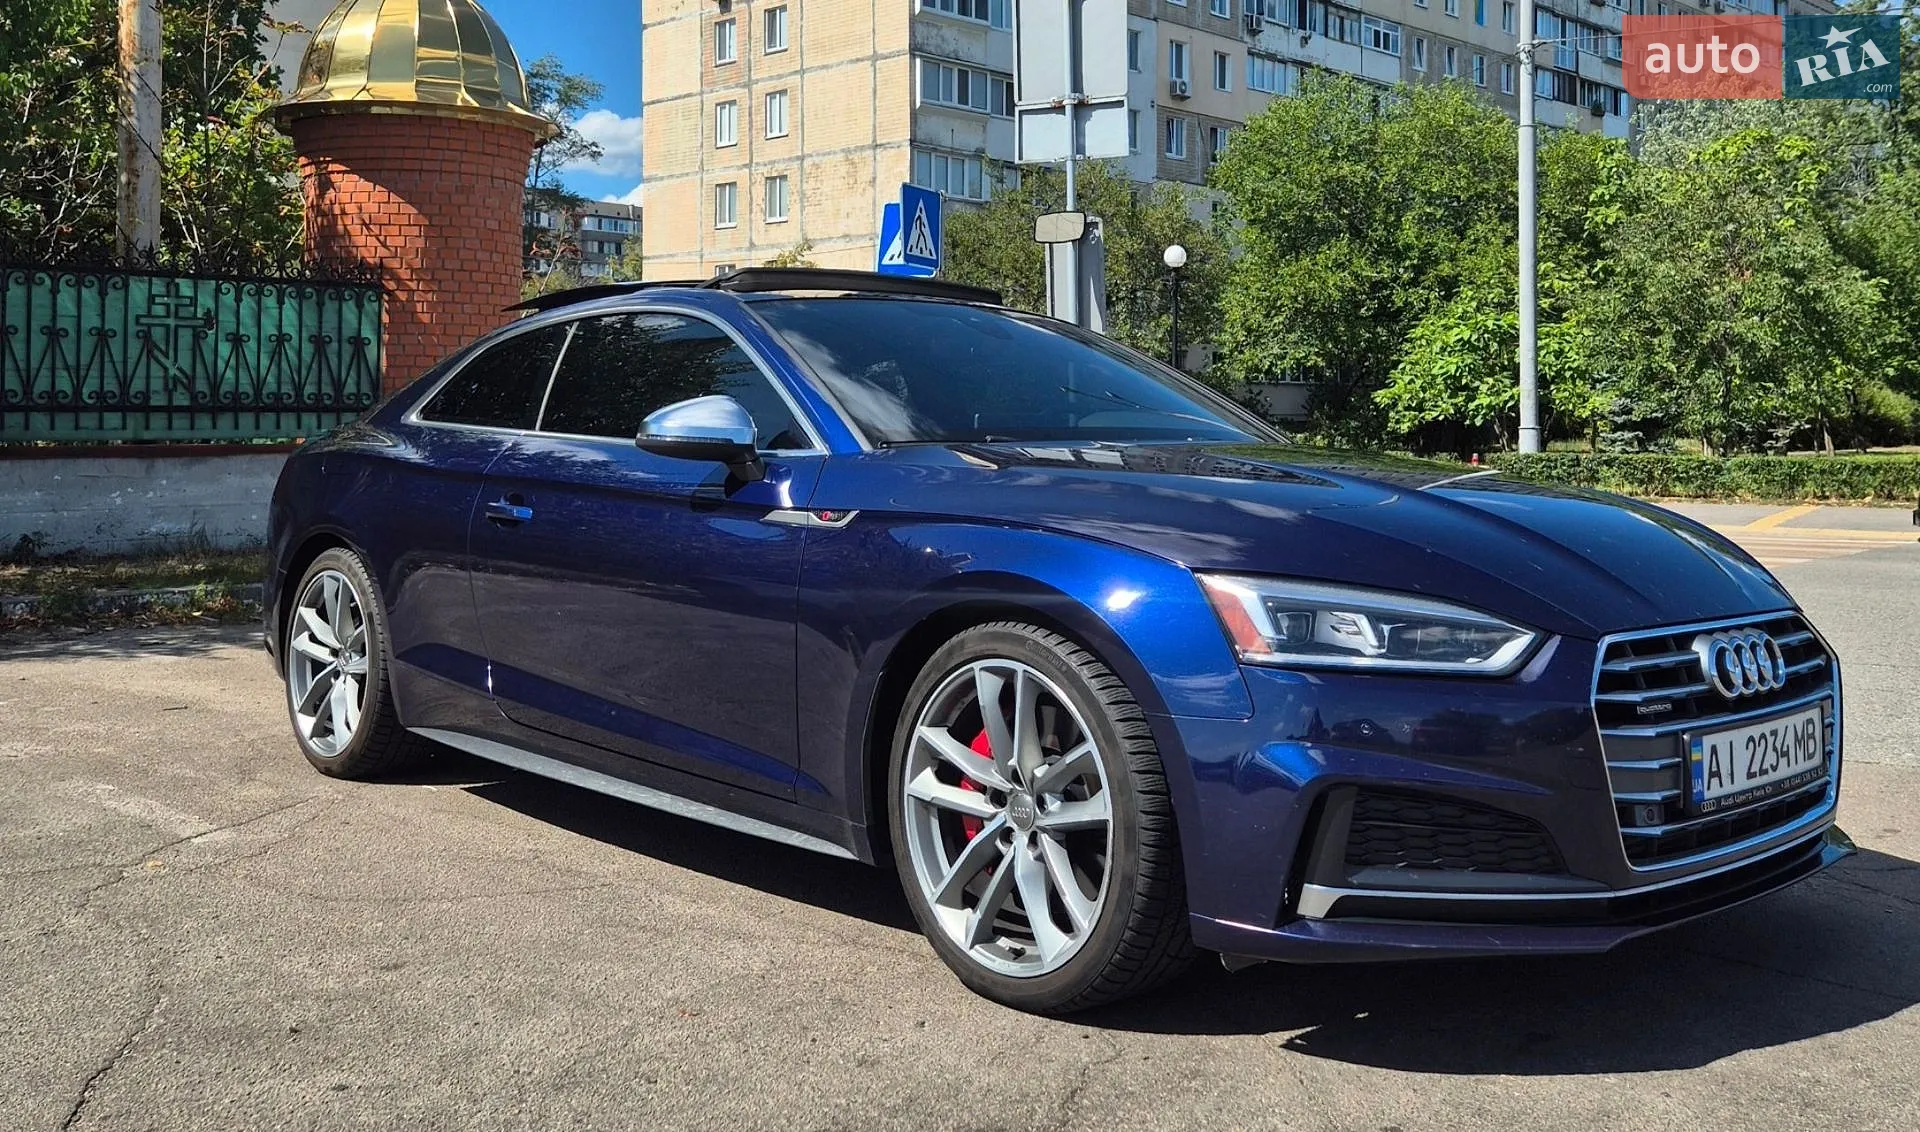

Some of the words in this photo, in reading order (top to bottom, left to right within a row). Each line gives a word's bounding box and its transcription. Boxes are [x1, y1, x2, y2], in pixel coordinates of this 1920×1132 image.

[1707, 740, 1735, 791] AI
[1746, 725, 1790, 780] 2234
[1794, 717, 1817, 766] MB
